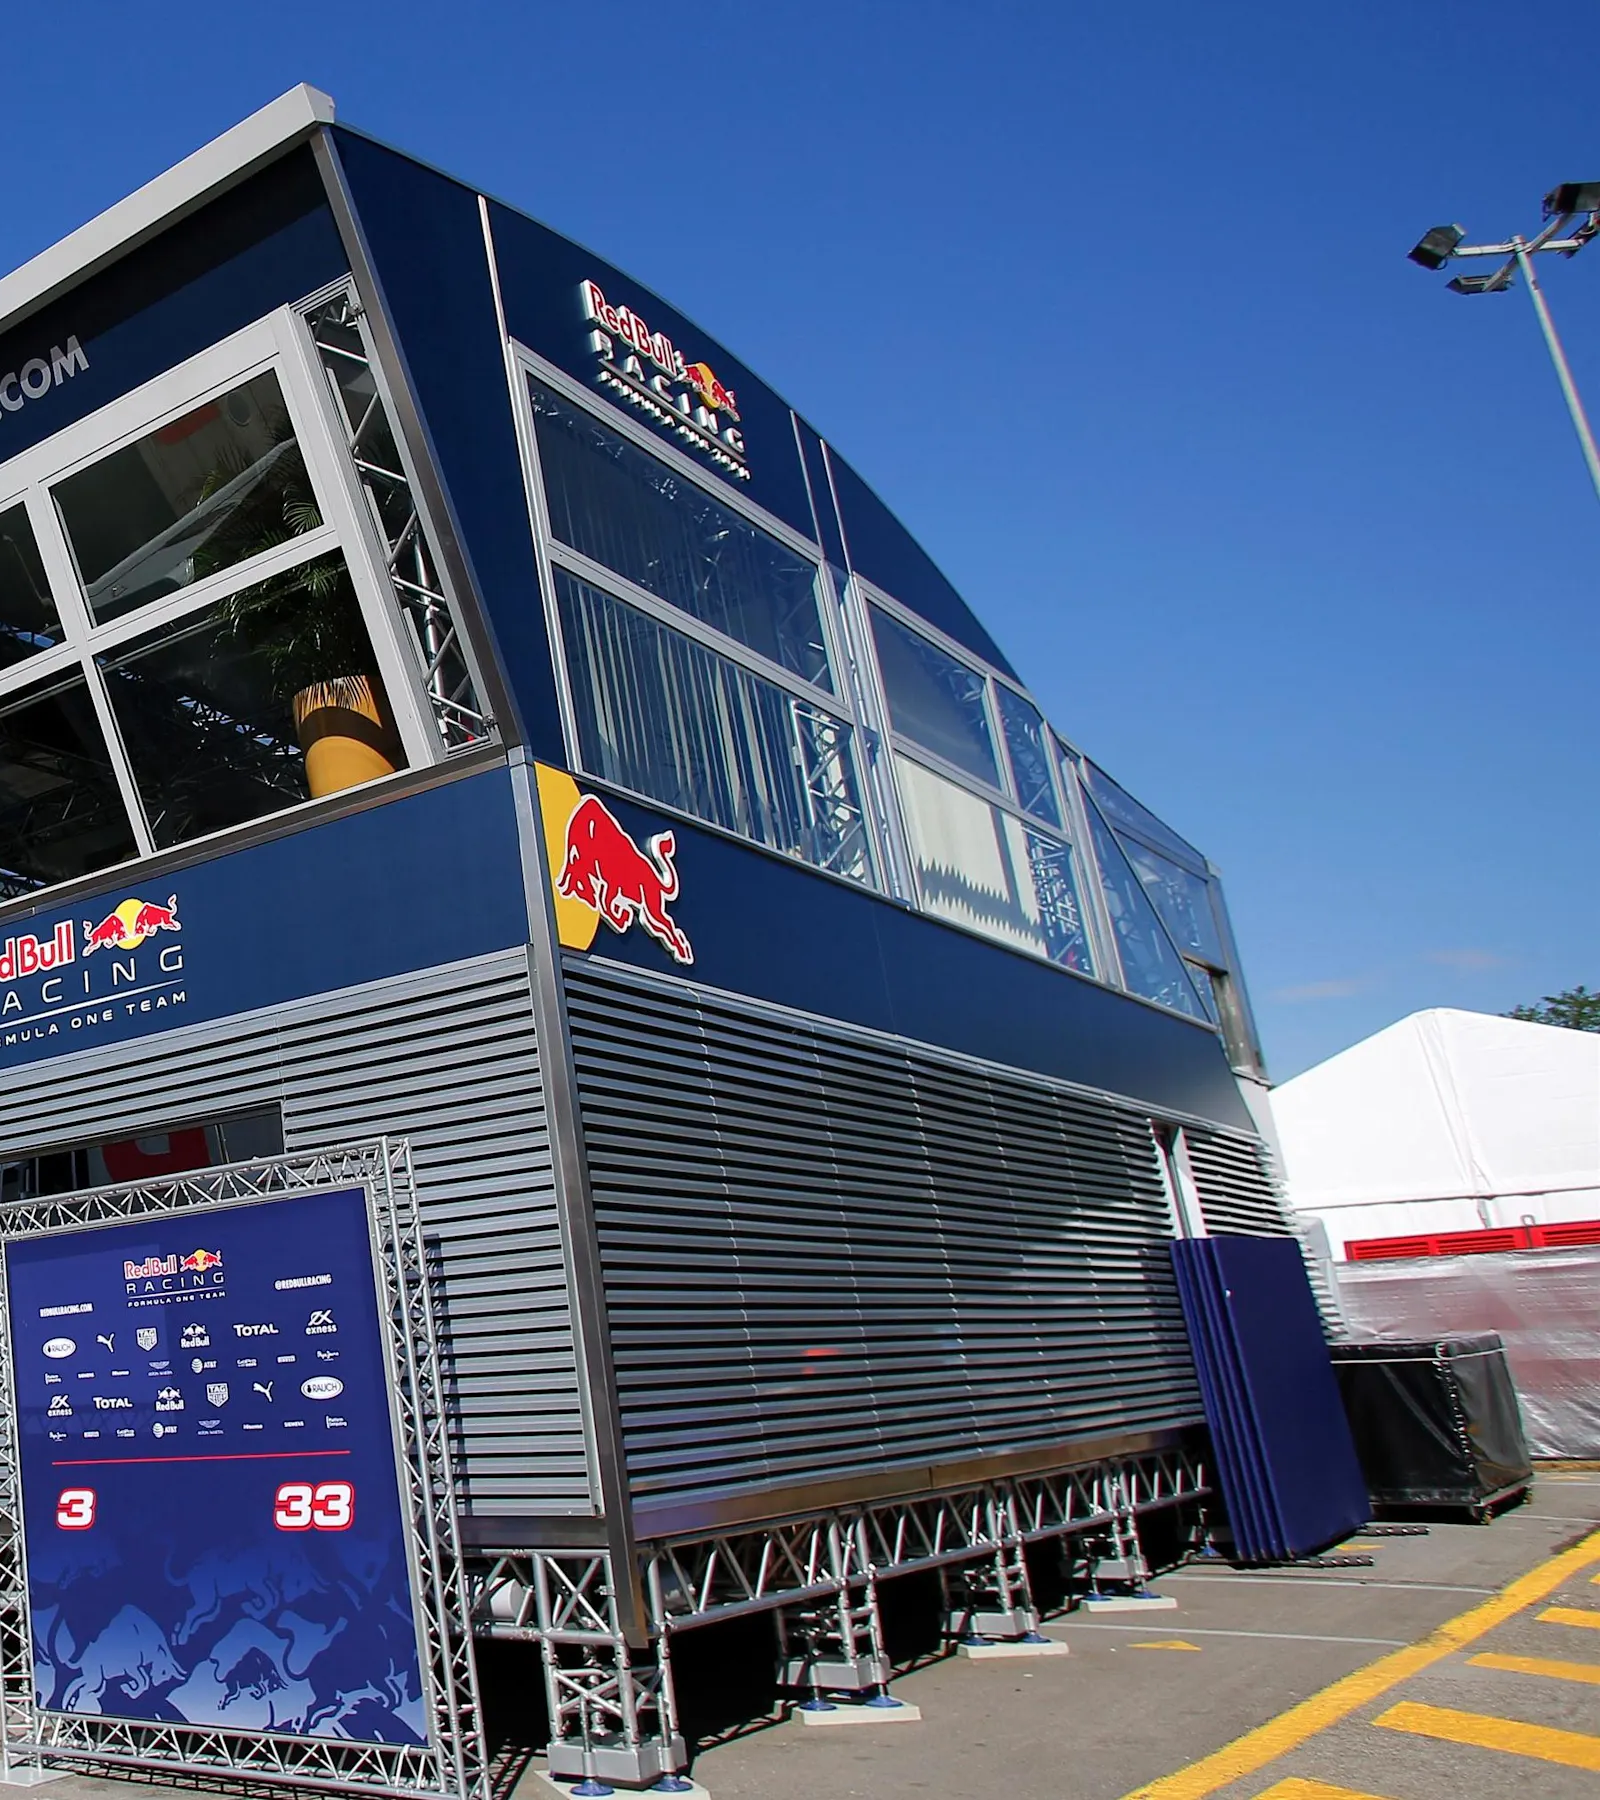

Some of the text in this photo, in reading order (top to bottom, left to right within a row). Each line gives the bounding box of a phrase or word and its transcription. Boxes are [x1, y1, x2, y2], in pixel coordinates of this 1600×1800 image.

[590, 328, 745, 453] RACING
[70, 1009, 113, 1029] ONE
[125, 991, 186, 1015] TEAM
[126, 1272, 224, 1295] RACING
[127, 1291, 226, 1308] FORMULA ONE TEAM
[139, 1329, 155, 1338] TAG
[305, 1325, 337, 1335] exness
[209, 1385, 226, 1394] TAG
[312, 1383, 337, 1392] RAUCH
[47, 1408, 73, 1417] exness
[56, 1488, 96, 1530] 3
[274, 1481, 354, 1531] 33
